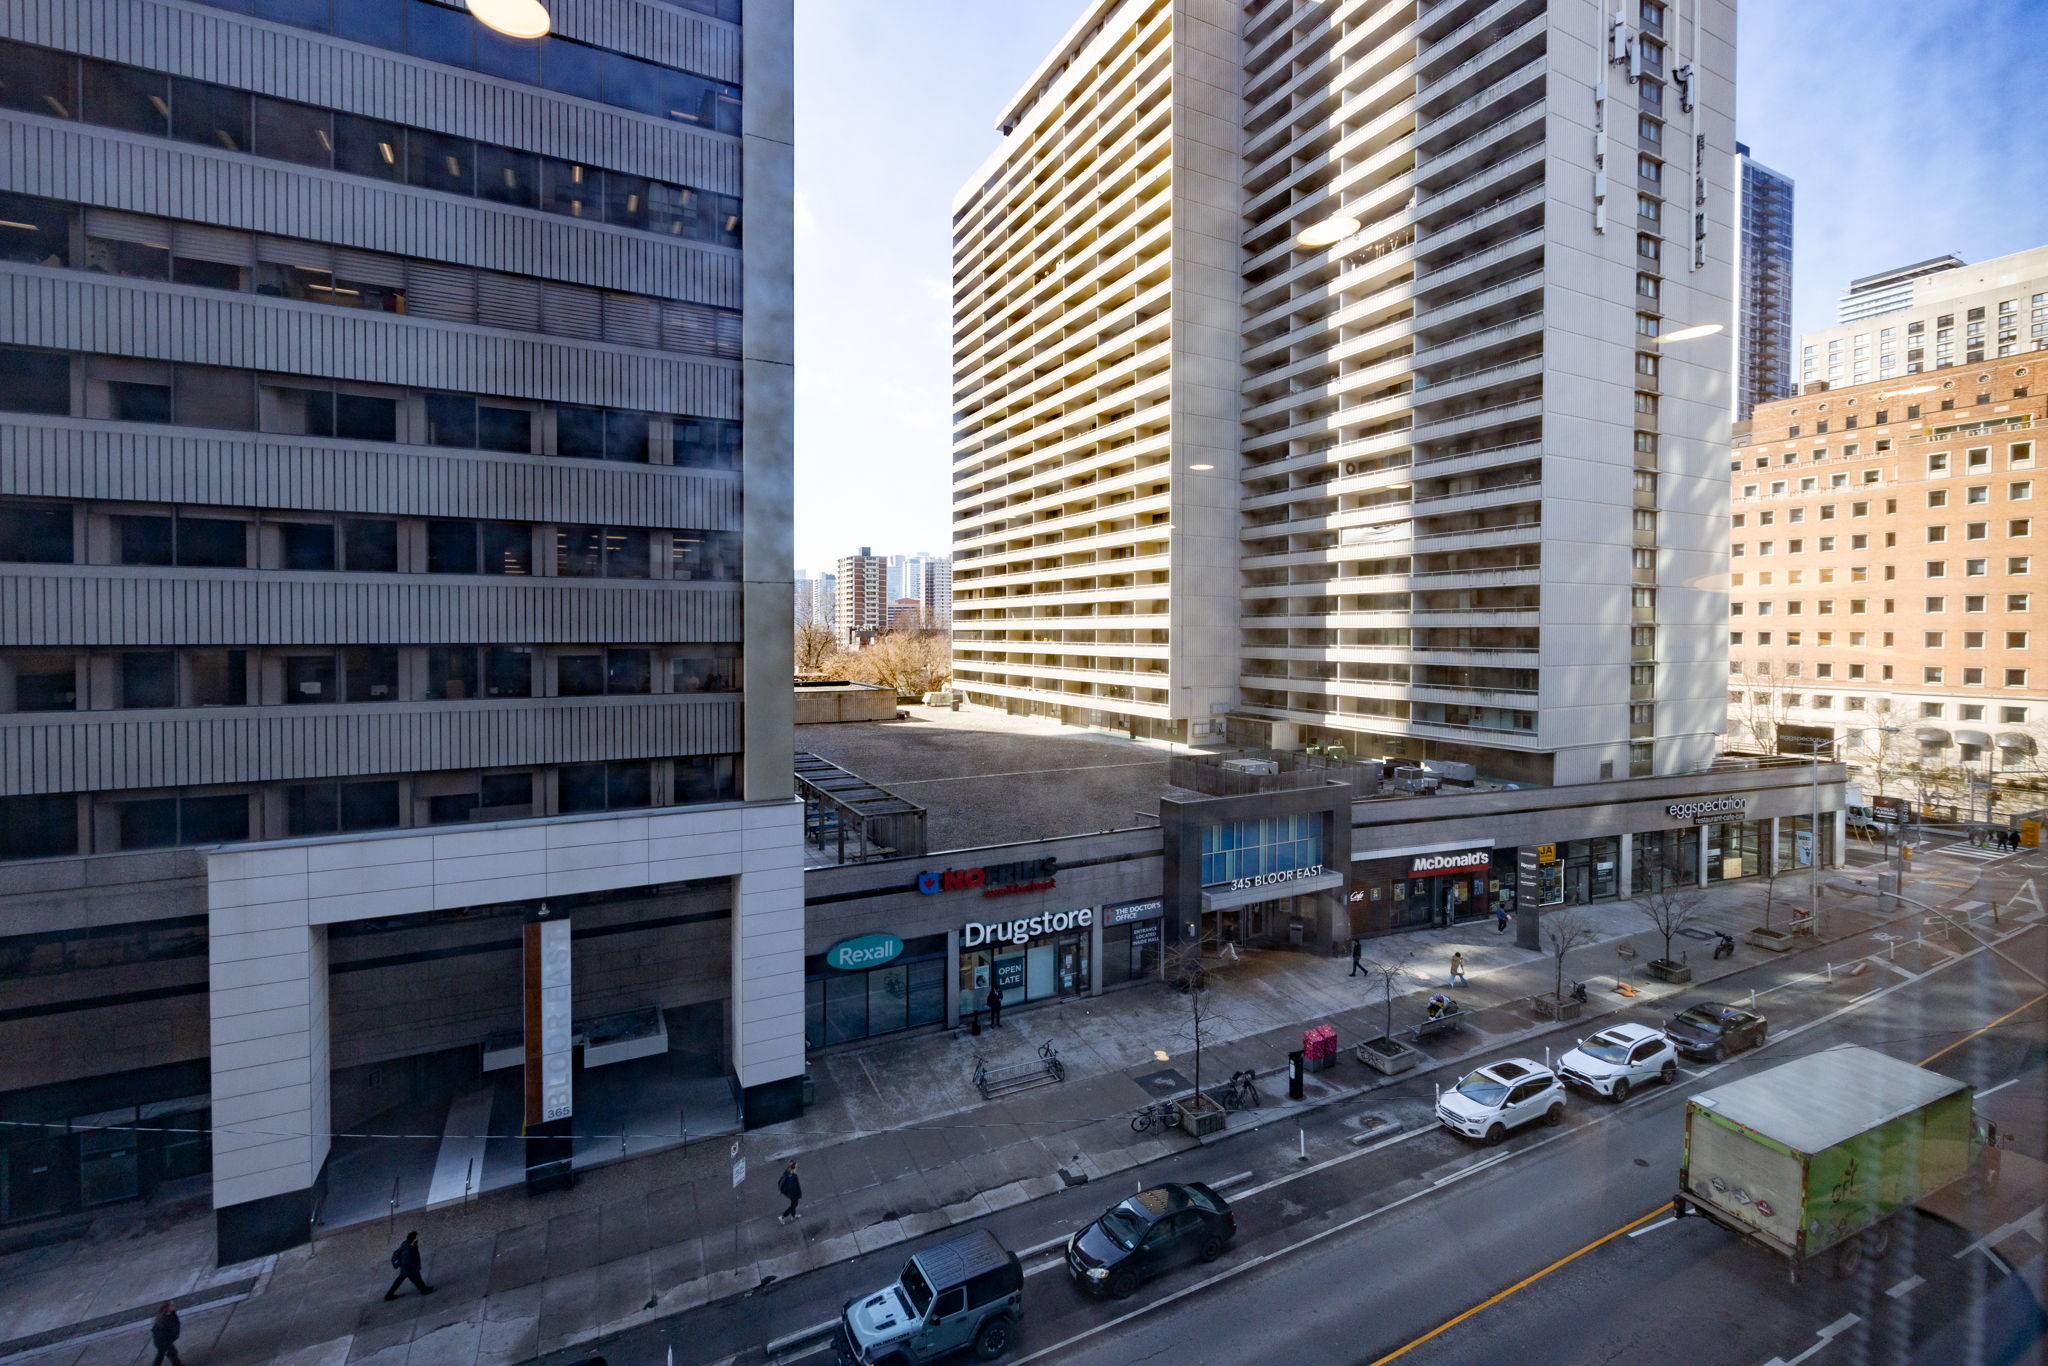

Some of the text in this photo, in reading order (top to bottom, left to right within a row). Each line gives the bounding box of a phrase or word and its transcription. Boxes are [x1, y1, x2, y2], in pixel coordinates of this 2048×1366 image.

[1669, 796, 1747, 819] eggspectation
[1413, 852, 1490, 872] McDonald's
[943, 867, 986, 892] NO
[1230, 865, 1323, 891] 345 BLOOR EAST
[1115, 901, 1161, 915] THE DOCTOR'S
[1115, 912, 1137, 921] OFFICE
[965, 908, 1093, 947] Drugstore
[1135, 932, 1157, 940] LOCATED
[839, 940, 894, 966] Rexall
[998, 964, 1022, 976] OPEN
[1000, 974, 1021, 986] LATE
[546, 927, 570, 1107] BLOOR EAST
[547, 1106, 571, 1119] 365
[872, 1332, 910, 1348] RUBICON
